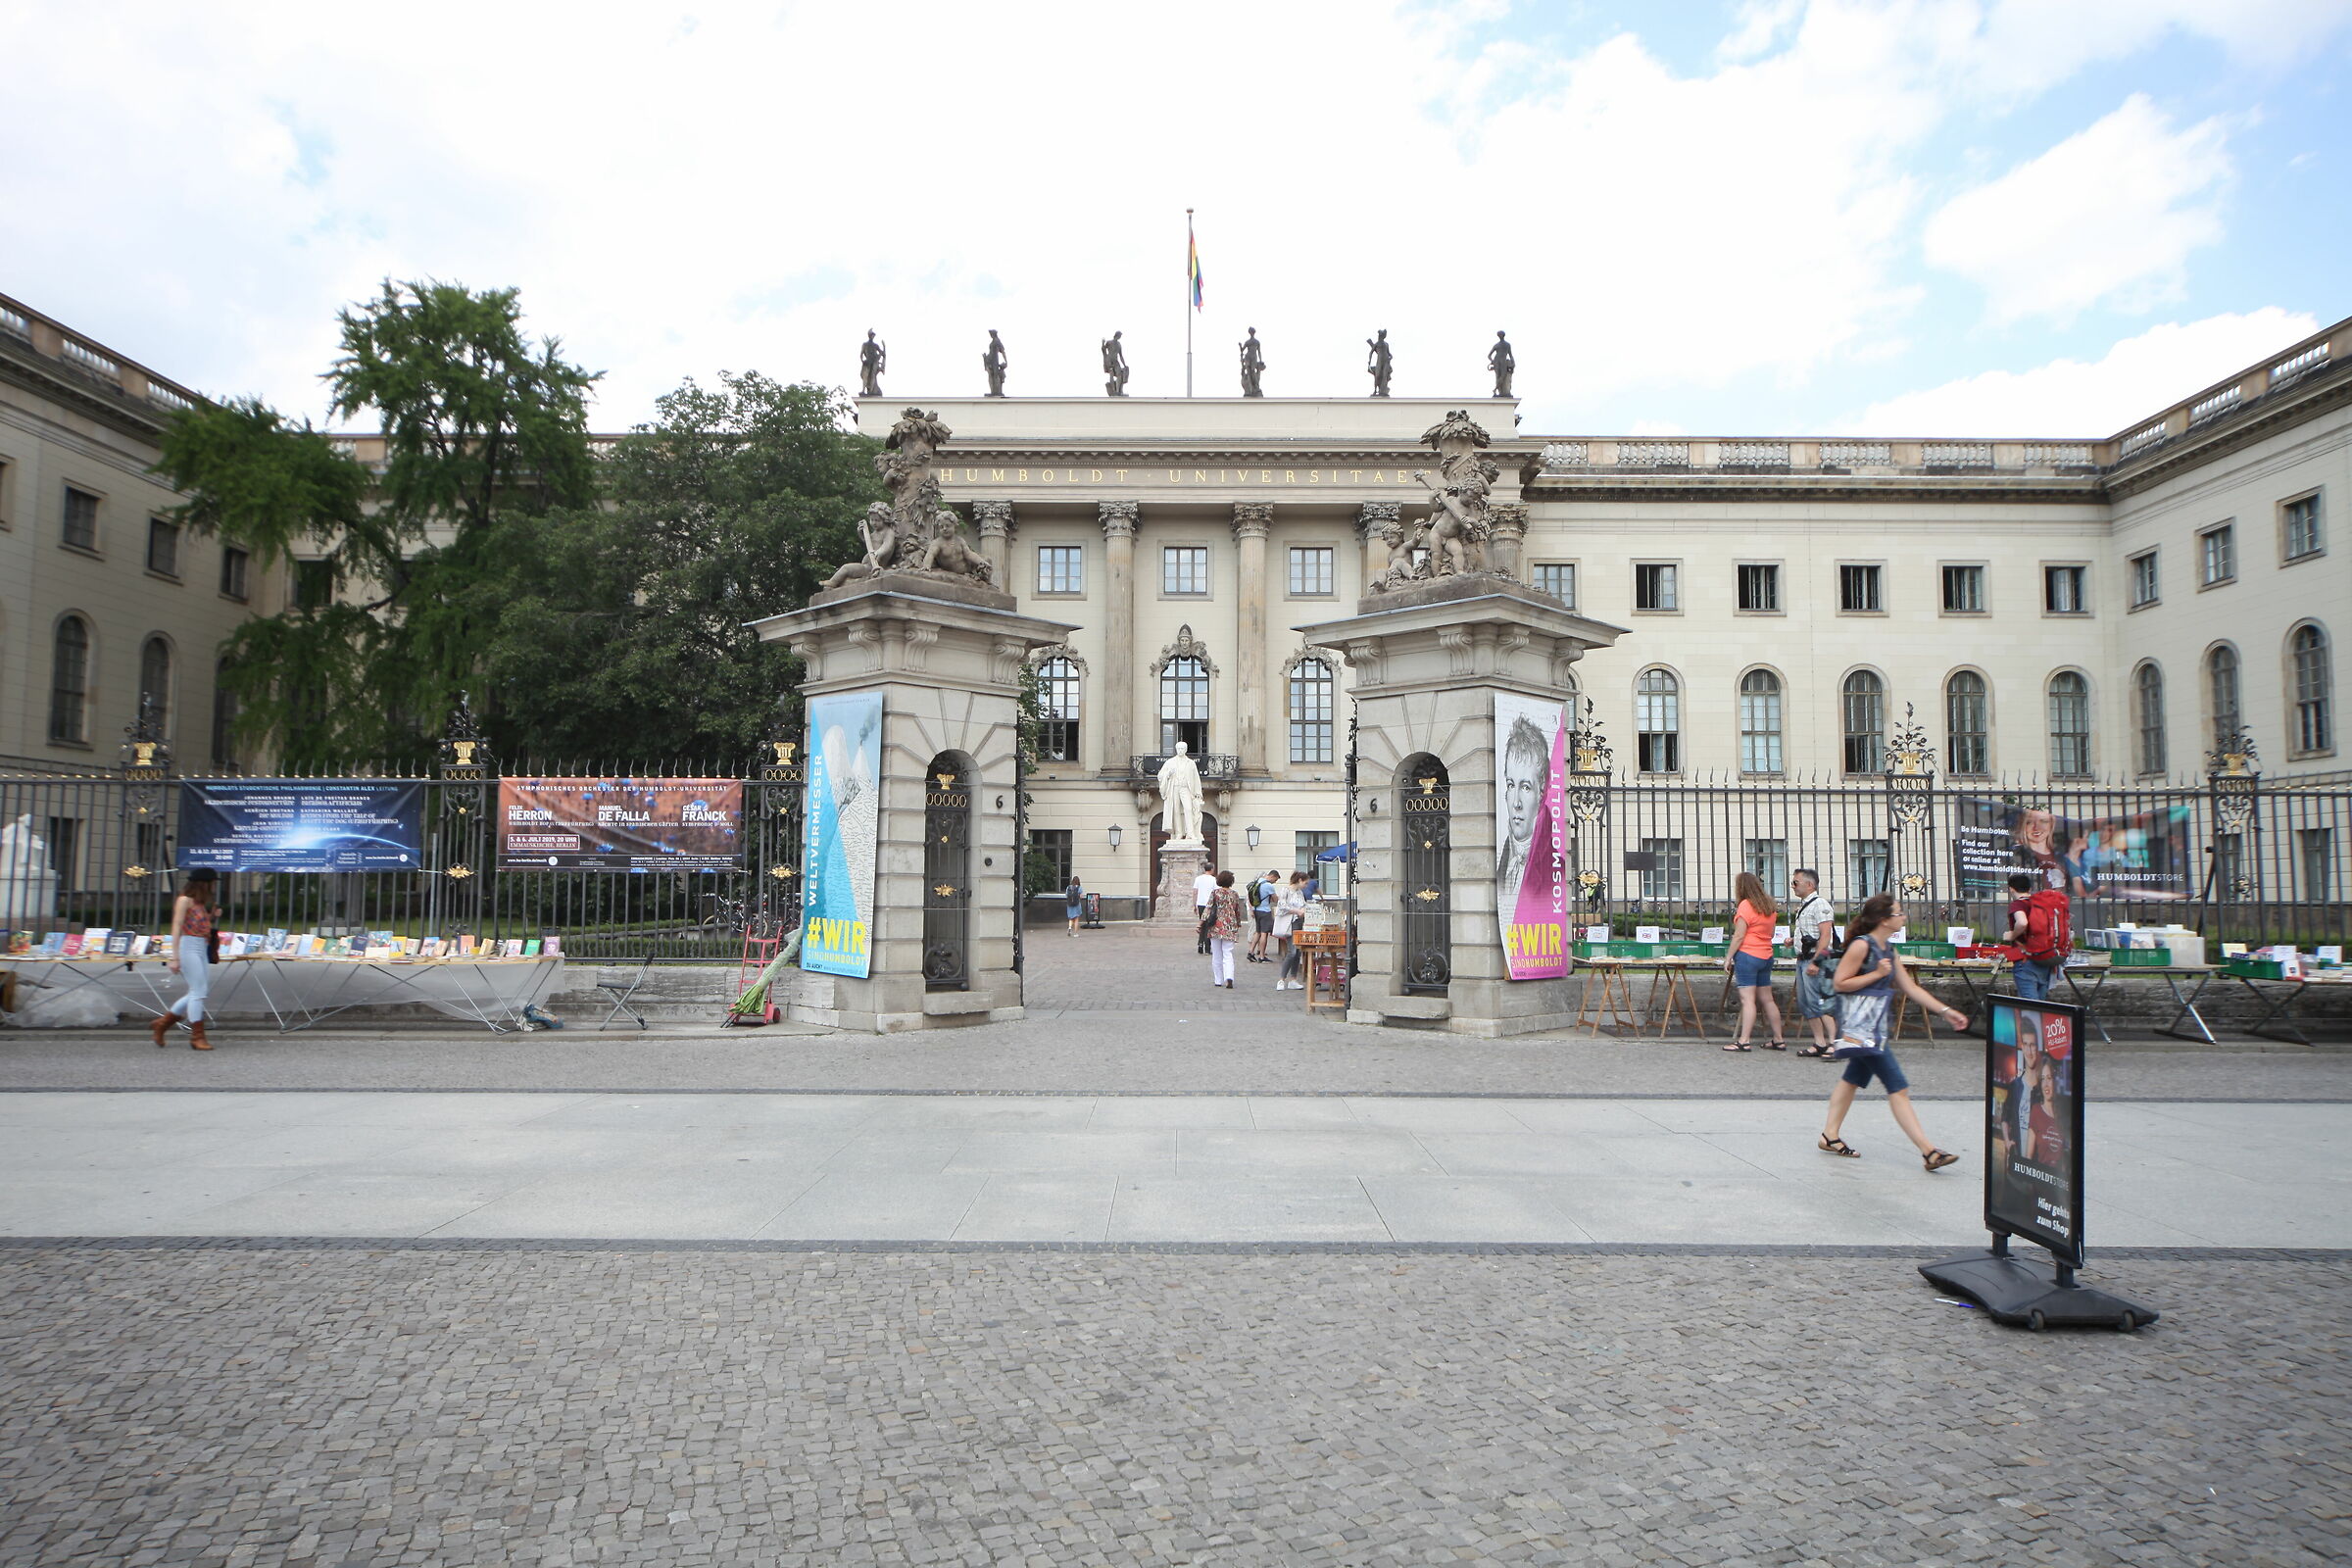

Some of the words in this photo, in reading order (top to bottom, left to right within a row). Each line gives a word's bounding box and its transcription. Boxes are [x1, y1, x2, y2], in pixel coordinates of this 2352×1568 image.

[940, 469, 1128, 483] HUMBOLDT
[996, 795, 1004, 808] 6
[1370, 798, 1377, 812] 6
[509, 810, 553, 820] HERRON
[598, 811, 612, 821] DE
[615, 811, 650, 821] FALLA
[682, 811, 727, 821] FRANCK
[808, 755, 822, 906] WELTVERMESSER
[1551, 769, 1562, 913] KOSMOPOLIT
[1963, 863, 2044, 874] www.humboldtstore.de
[807, 916, 866, 955] #WIR
[1506, 923, 1562, 956] #WIR
[807, 950, 868, 966] SINDHUMBOLDT
[1511, 956, 1563, 968] SINDHUMBOLDT
[2046, 1018, 2066, 1037] 20%
[2014, 1162, 2069, 1192] HUMBOLDTSTORE
[2037, 1197, 2052, 1212] Hier
[2052, 1205, 2070, 1220] gehts
[2036, 1215, 2052, 1229] zum
[2052, 1219, 2070, 1239] Shop
